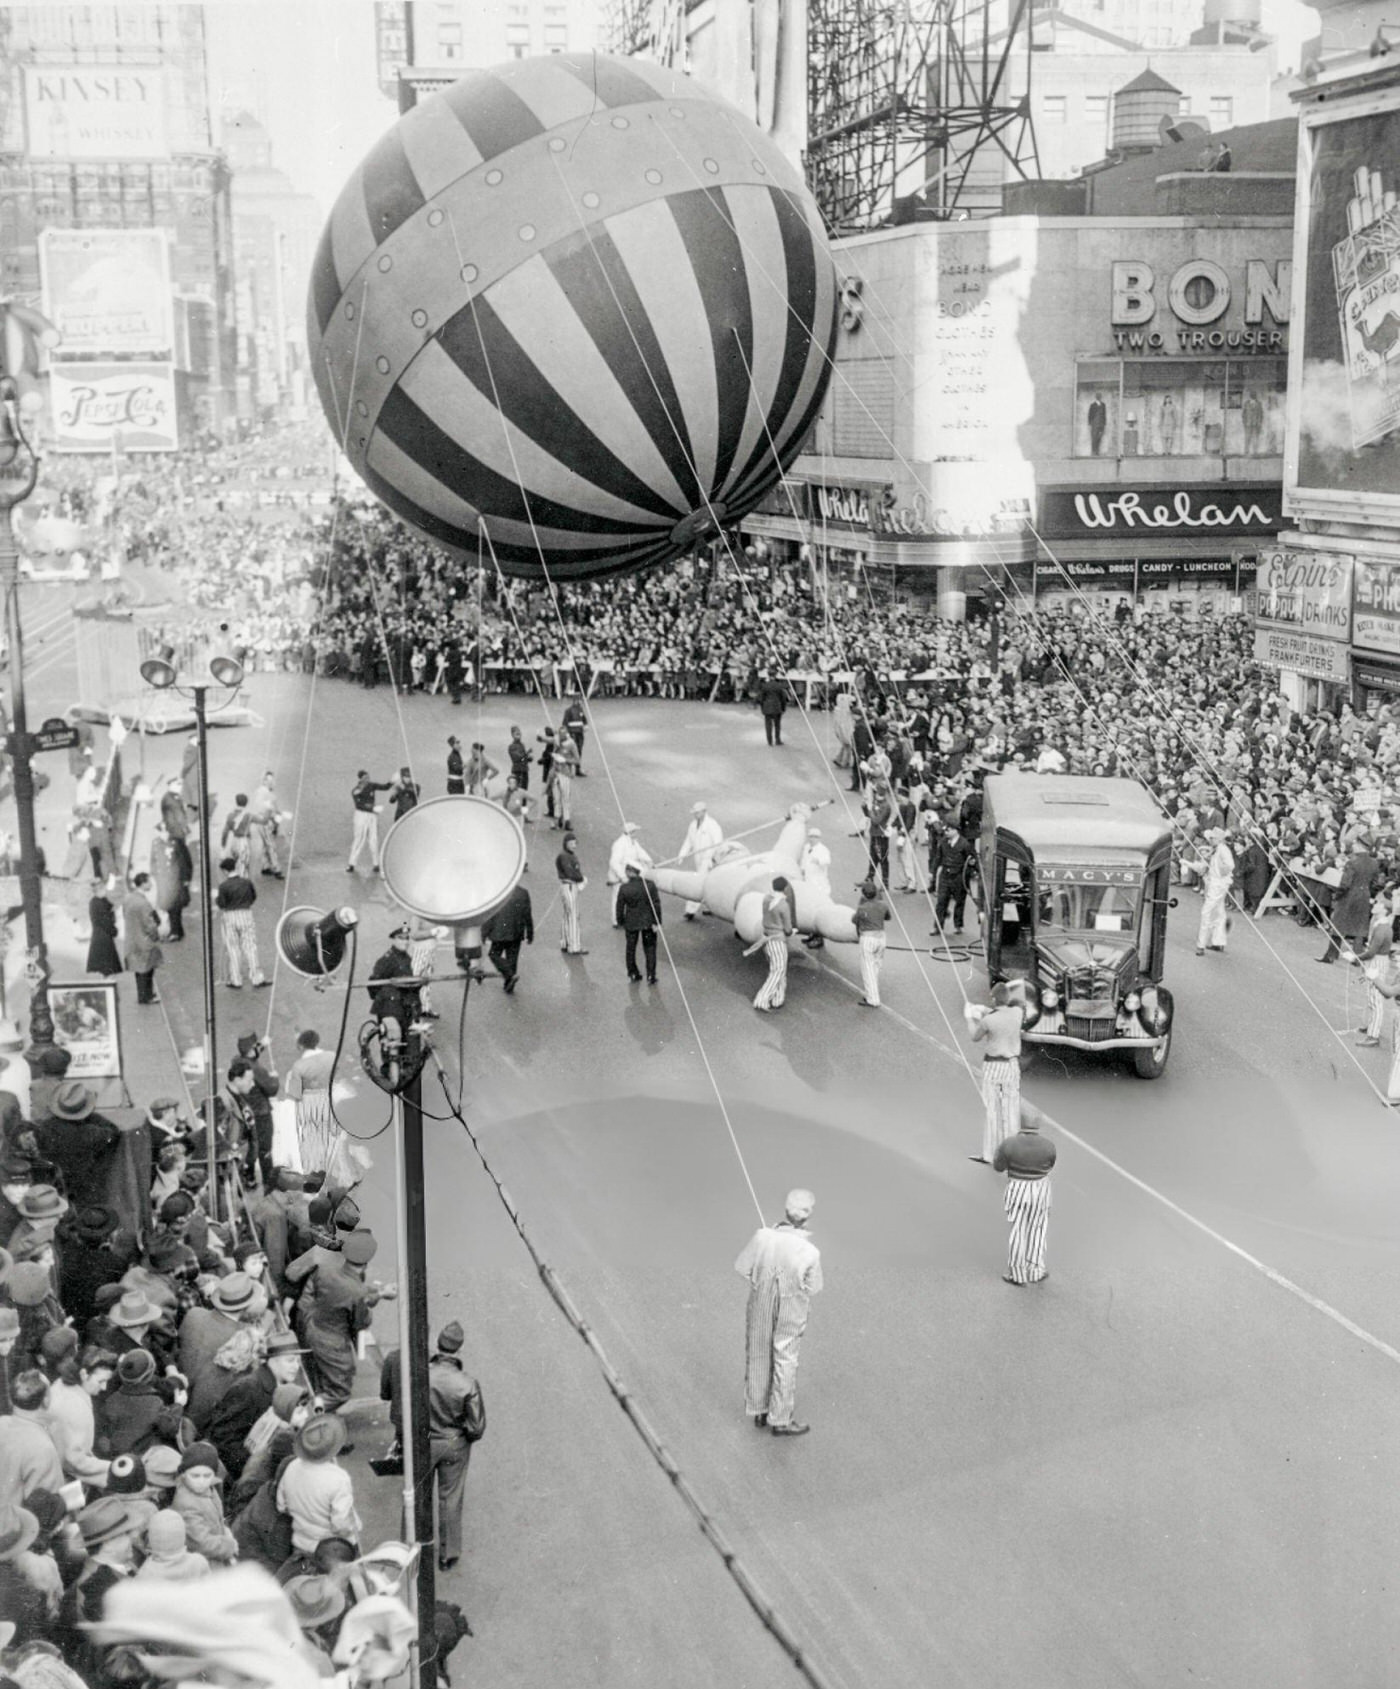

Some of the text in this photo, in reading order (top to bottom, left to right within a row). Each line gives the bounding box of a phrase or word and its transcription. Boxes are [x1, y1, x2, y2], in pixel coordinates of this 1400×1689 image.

[36, 76, 150, 102] KINSEY
[1111, 258, 1291, 326] BON
[938, 300, 992, 319] BOND
[1113, 330, 1283, 350] TWO TROUSER
[1074, 491, 1272, 528] Whelan
[1108, 564, 1135, 573] DRUGS
[1142, 563, 1174, 572] CANDY
[1184, 562, 1232, 571] LUNCHEON
[1240, 563, 1258, 571] KOD
[1306, 602, 1348, 627] DRINKS
[1269, 635, 1335, 658] FRESH FRUIT DRINKS
[1269, 648, 1334, 672] FRANKFURTERS
[1042, 869, 1135, 882] MACY'S
